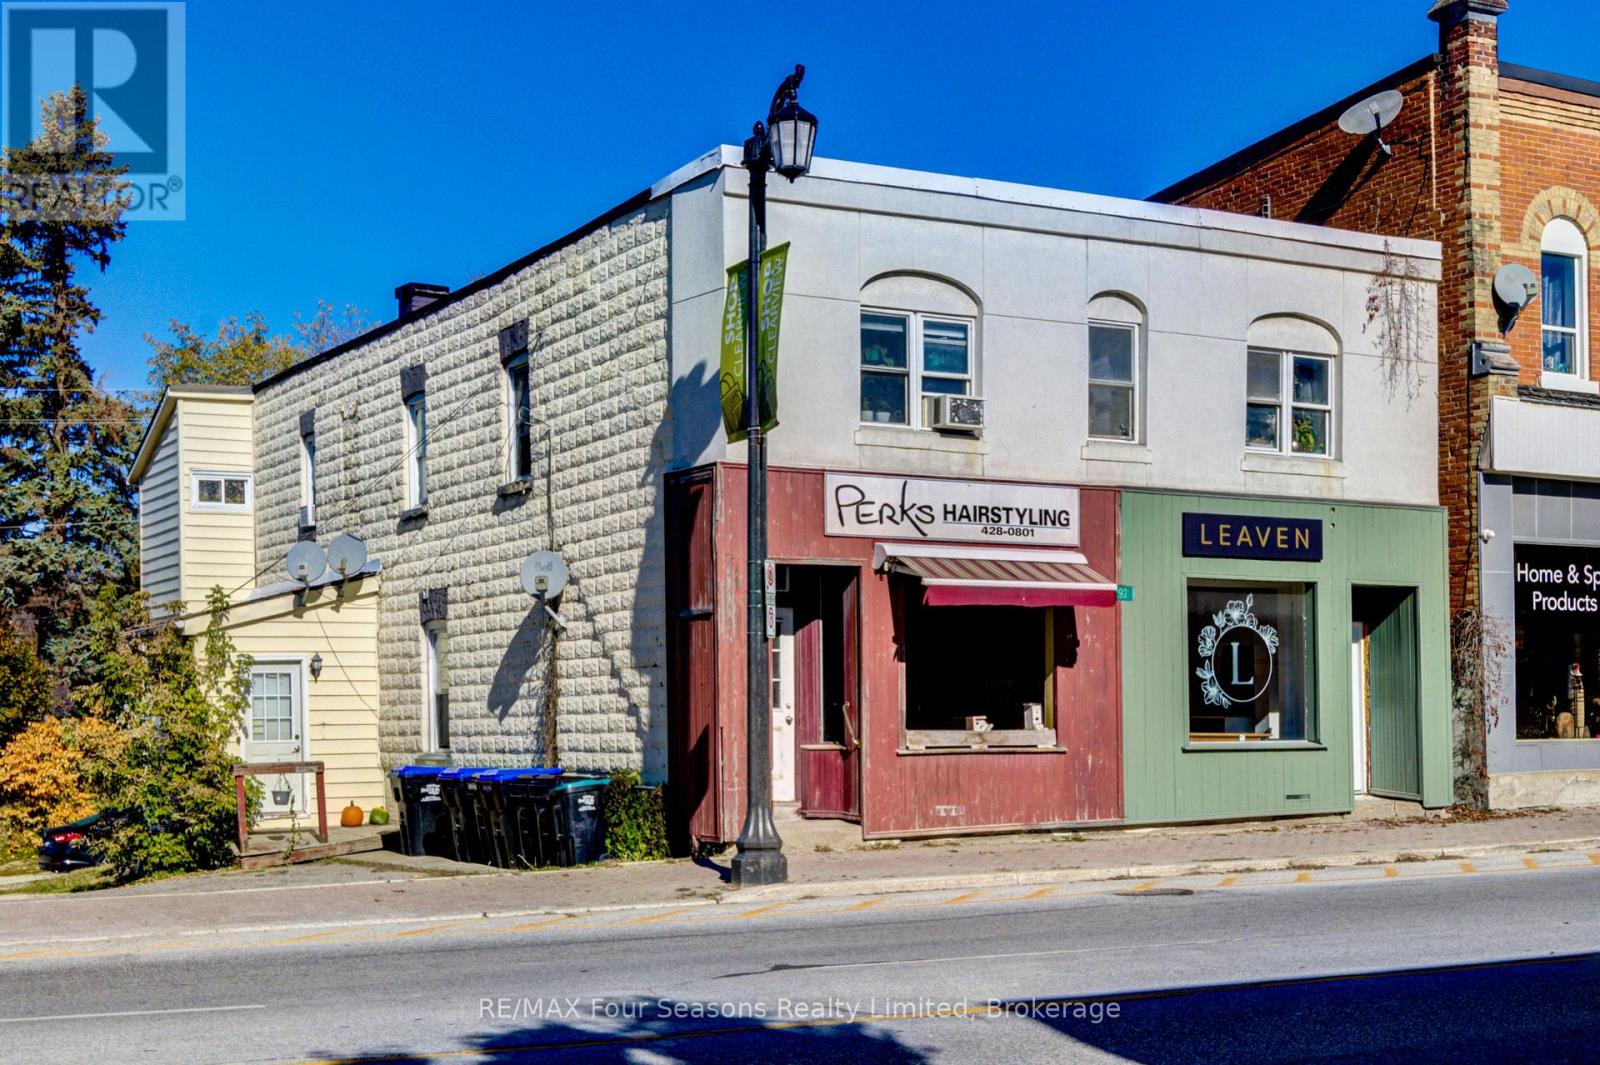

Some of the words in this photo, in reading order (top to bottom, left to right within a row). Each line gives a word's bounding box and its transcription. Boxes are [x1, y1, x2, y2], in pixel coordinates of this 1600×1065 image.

[725, 275, 738, 345] SHOP
[760, 262, 773, 332] SHOP
[767, 258, 785, 364] CLEARVIEW
[942, 503, 1071, 528] HAIRSTYLING
[981, 526, 1035, 538] 428-0801
[1200, 523, 1310, 550] LEAVEN
[1516, 562, 1564, 583] Home
[1567, 564, 1580, 584] &
[1532, 590, 1598, 612] Products
[1230, 642, 1254, 685] L
